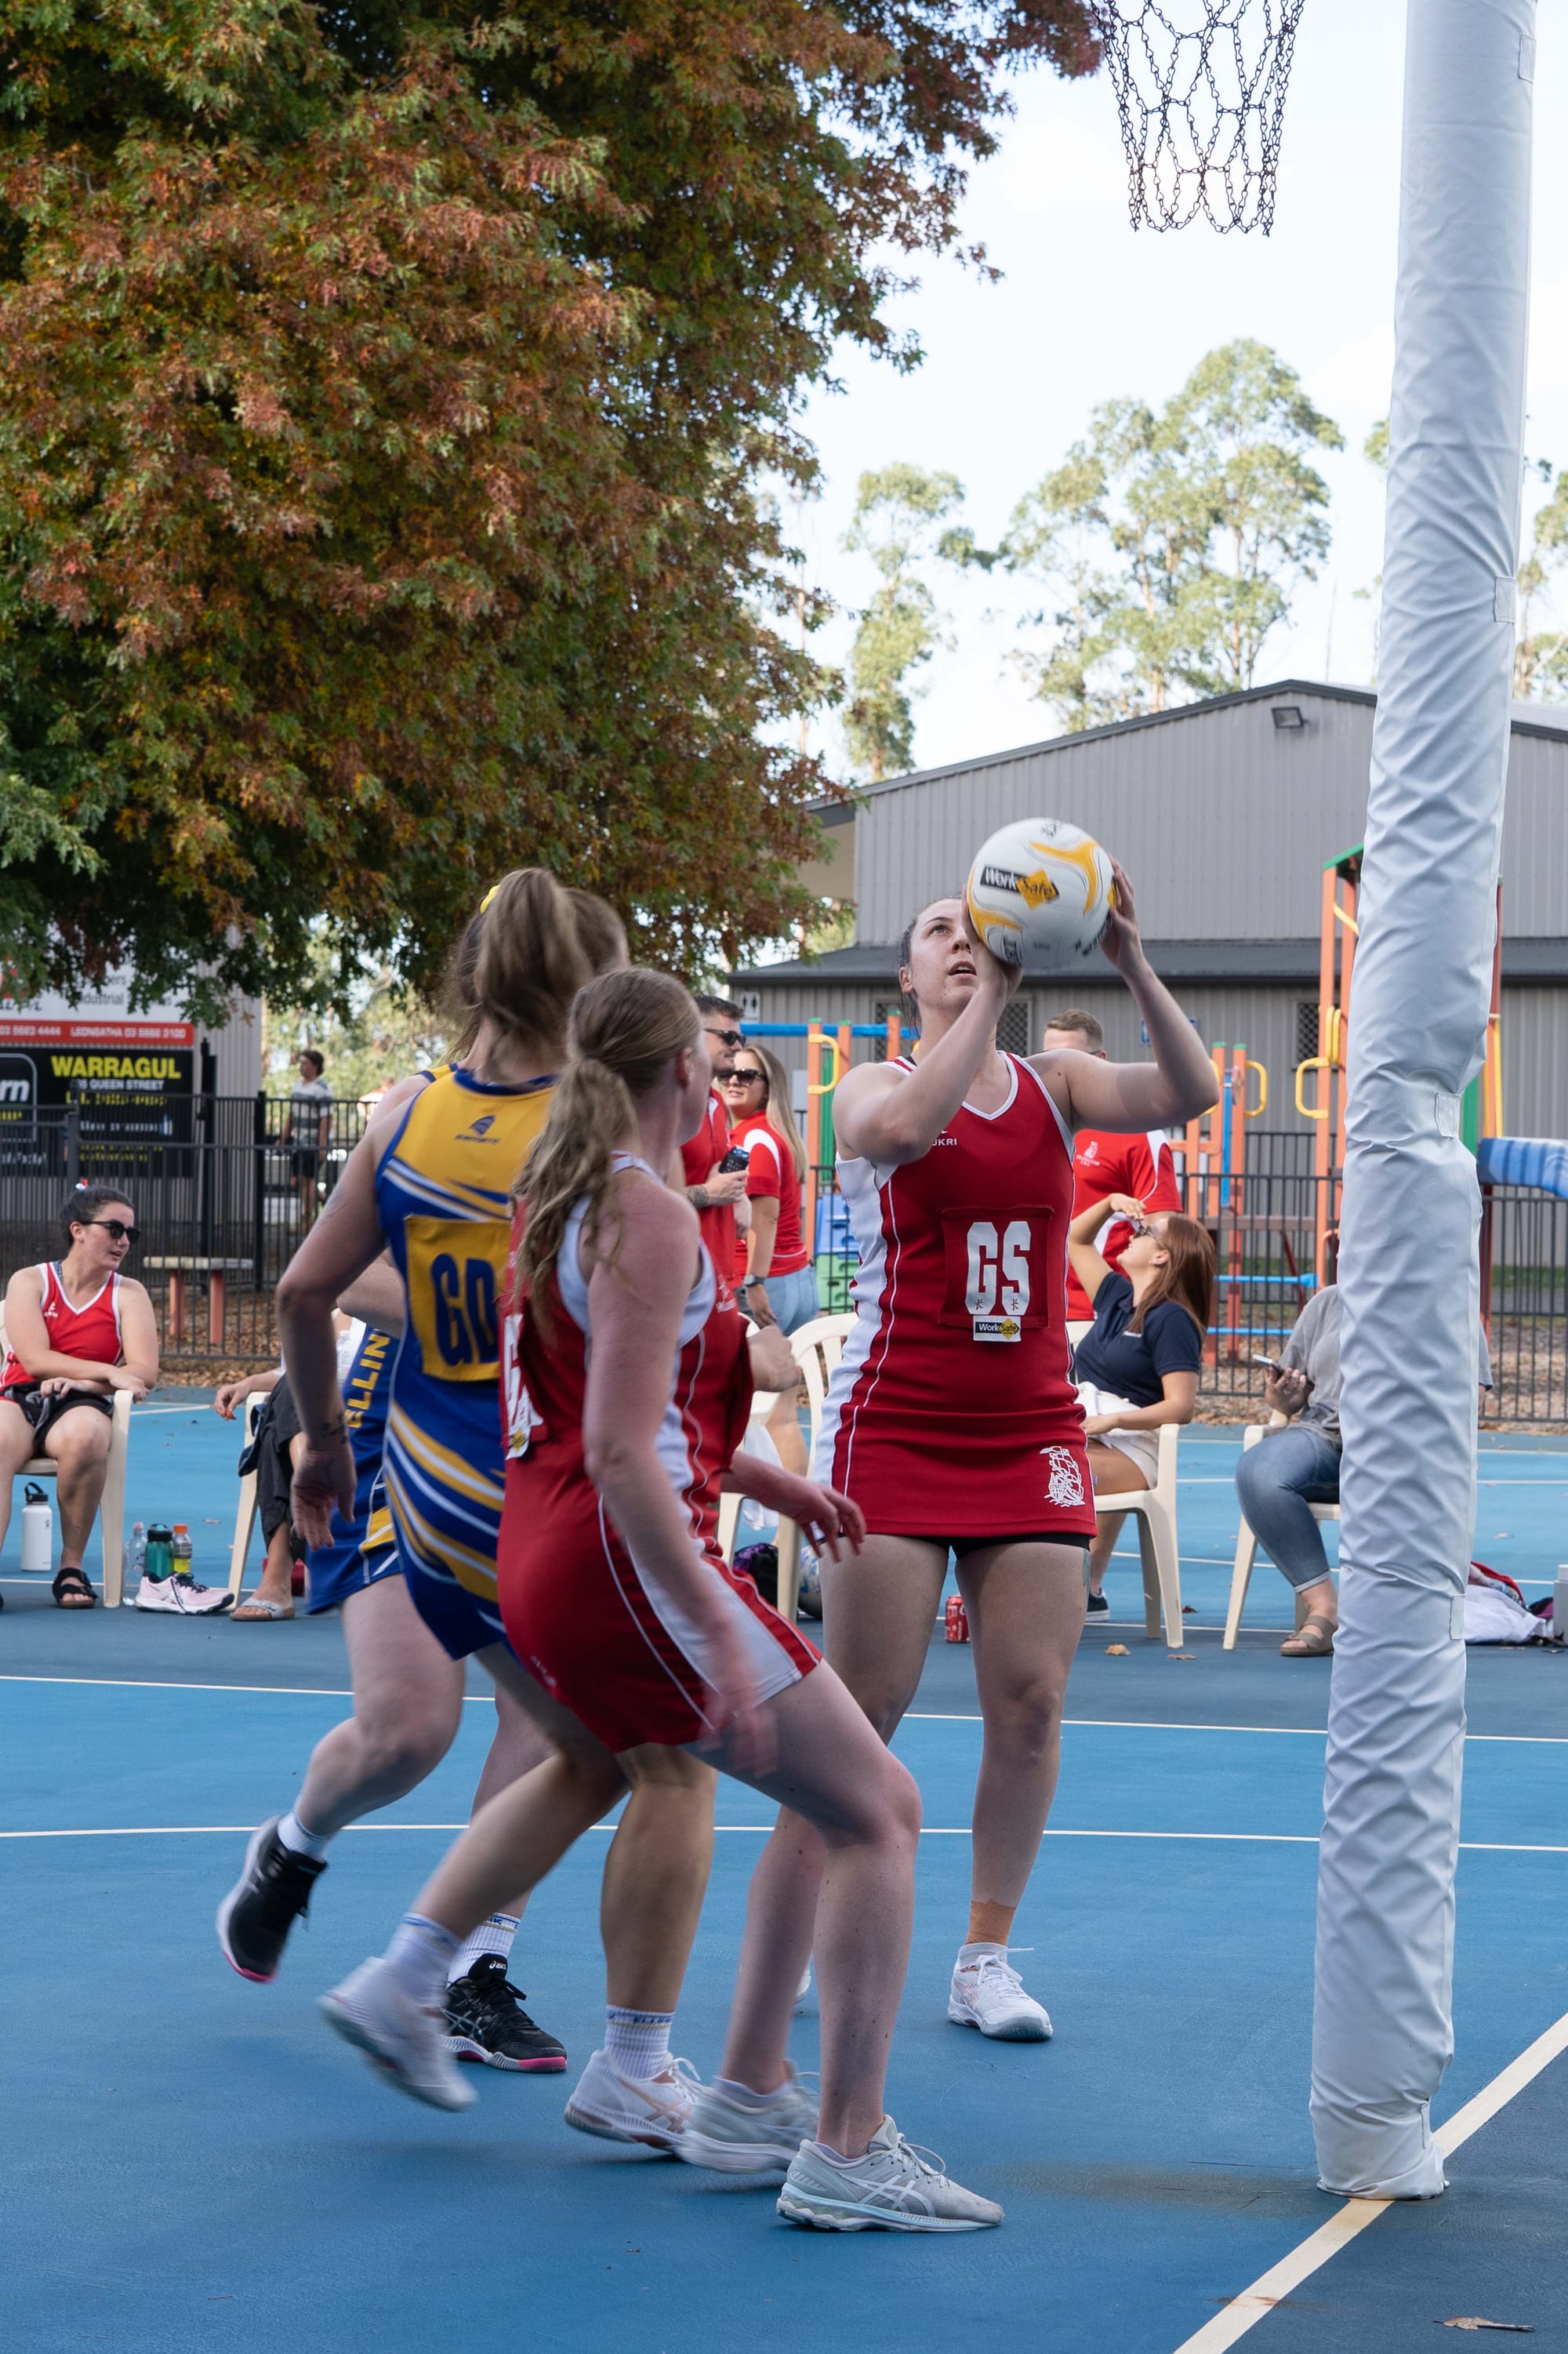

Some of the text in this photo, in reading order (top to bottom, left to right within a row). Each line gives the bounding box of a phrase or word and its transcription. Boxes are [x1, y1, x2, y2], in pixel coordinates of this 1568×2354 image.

[50, 1055, 182, 1079] WARRAGUL
[89, 1079, 125, 1091] QUEEN
[125, 1080, 165, 1091] STREET
[965, 1221, 1031, 1315] GS
[430, 1252, 499, 1366] GD
